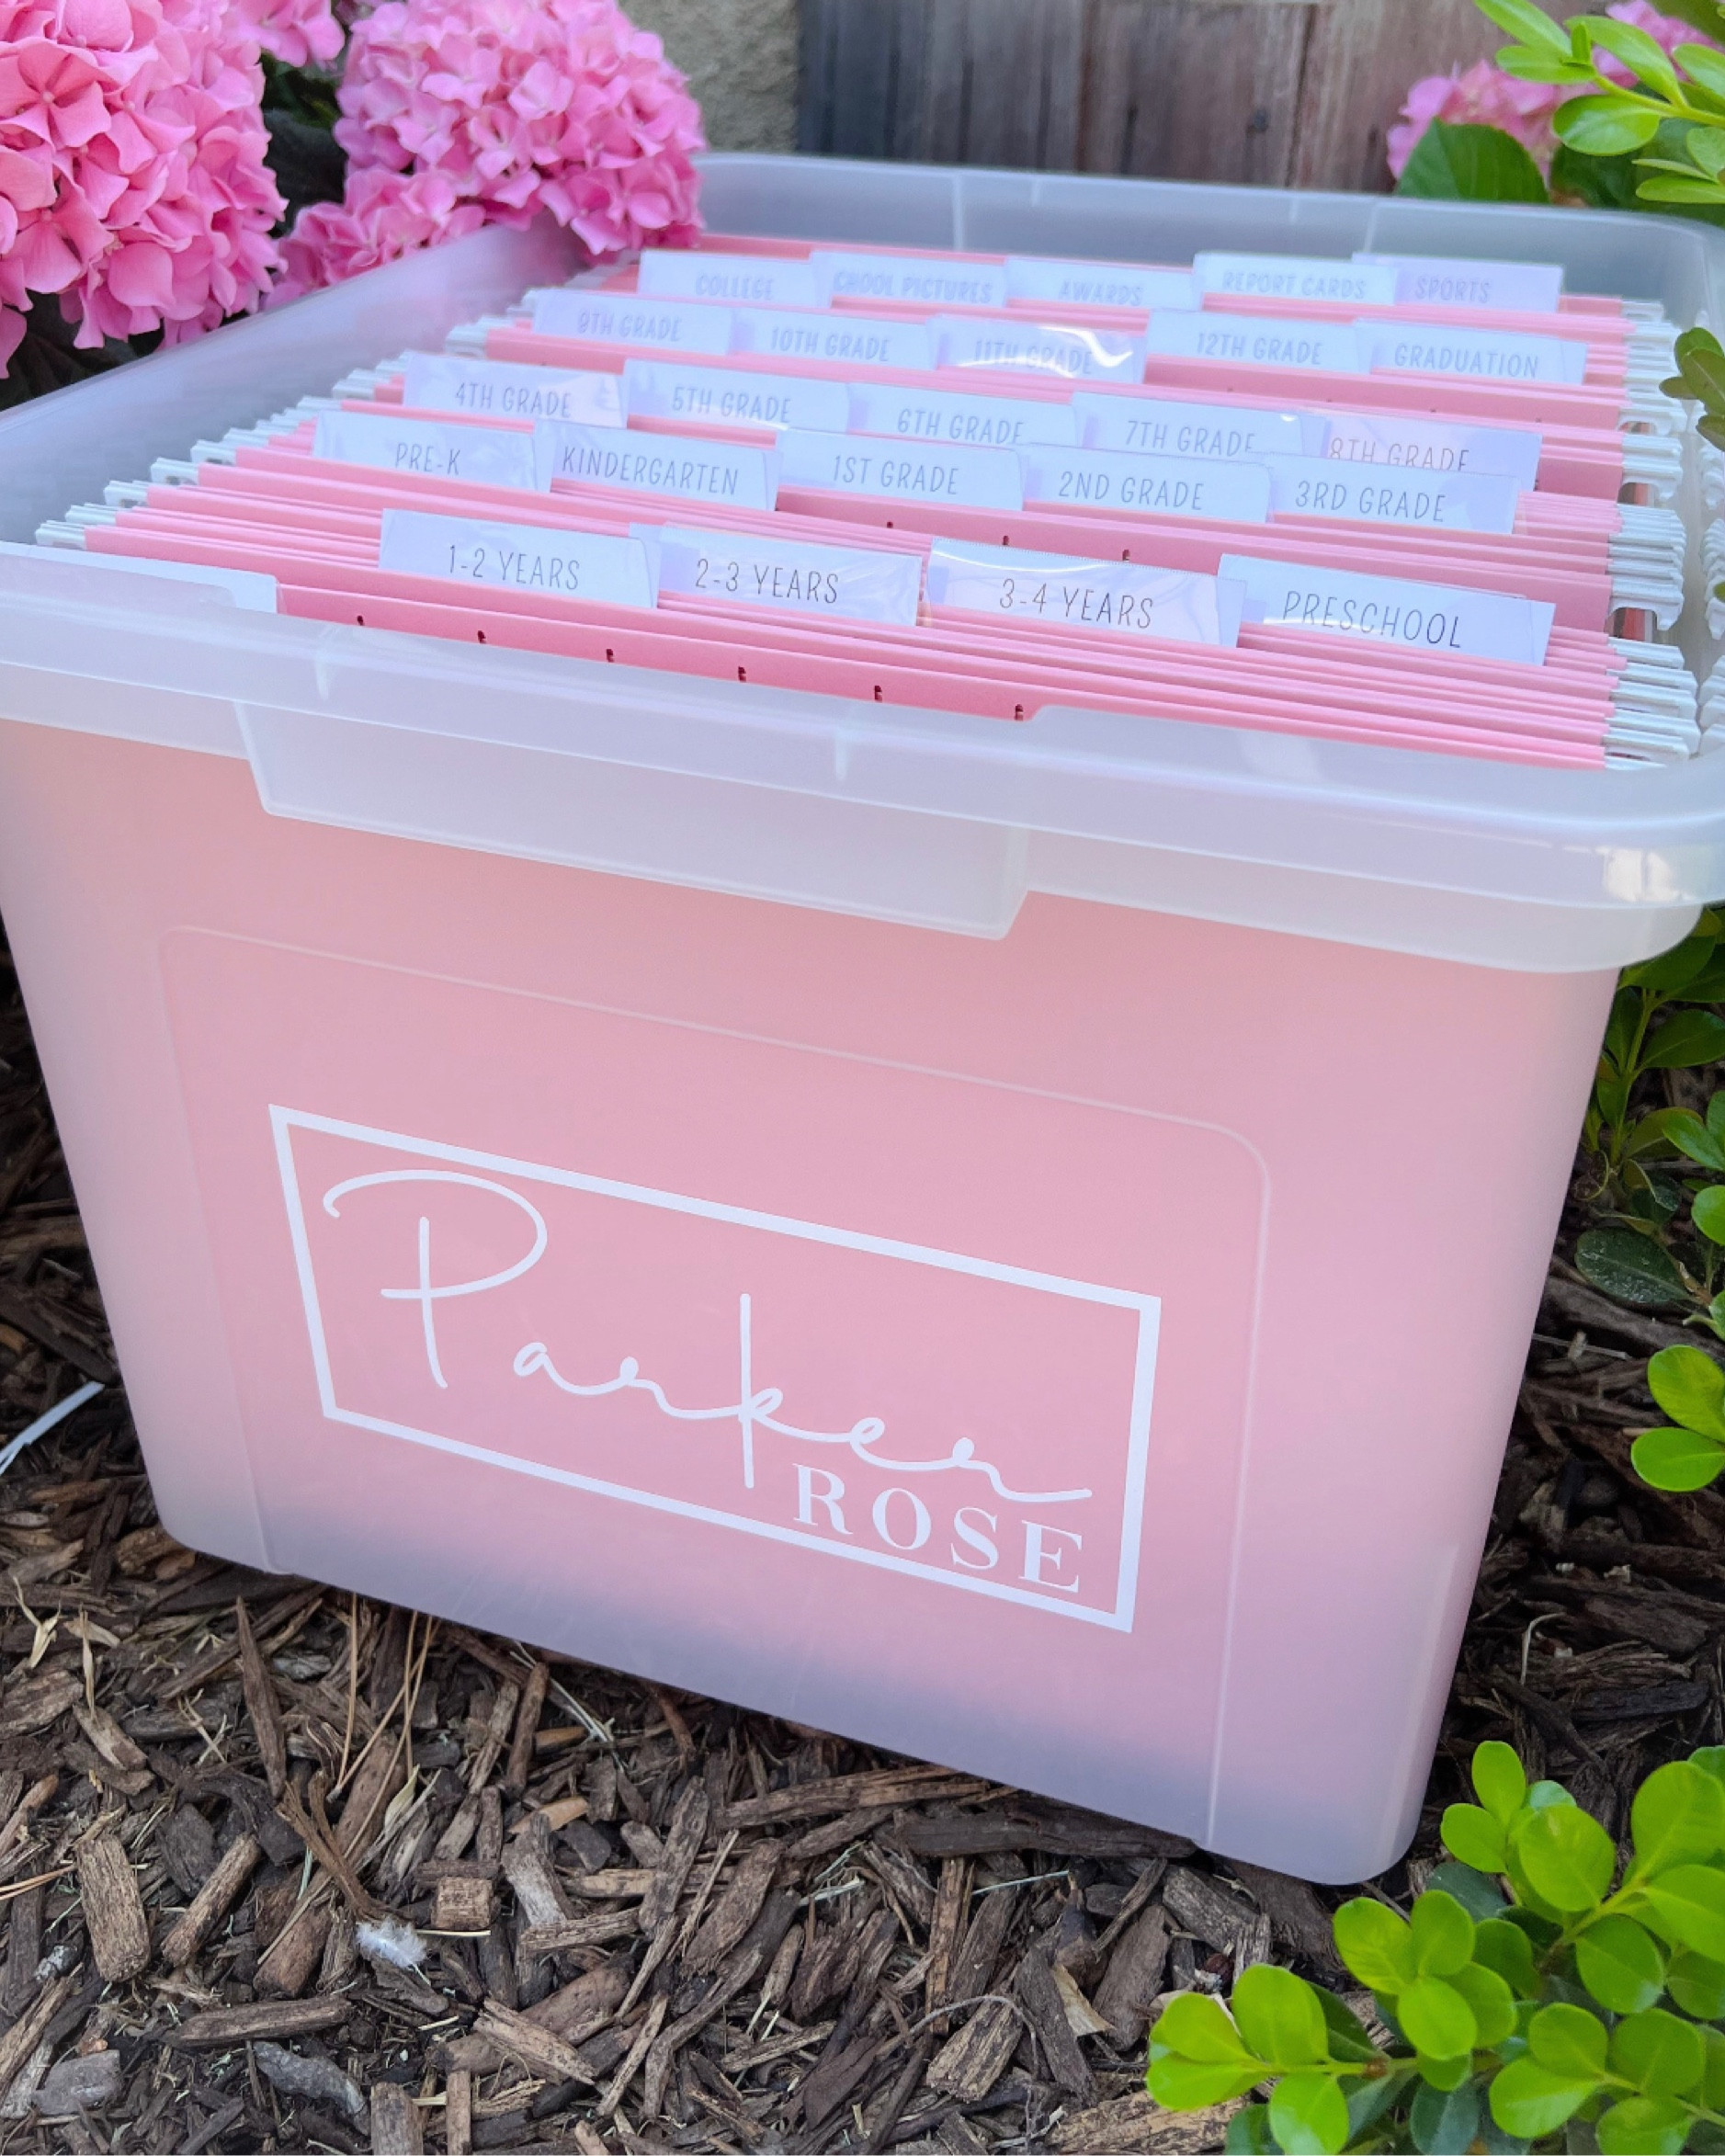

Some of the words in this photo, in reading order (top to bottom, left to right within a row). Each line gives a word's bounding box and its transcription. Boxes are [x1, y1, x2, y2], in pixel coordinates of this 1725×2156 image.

[695, 275, 774, 301] COLLEGE
[1059, 279, 1142, 306] AWARDS
[1222, 272, 1296, 294] REPORT
[1301, 277, 1367, 300] CARDS
[1414, 278, 1491, 304] SPORTS
[619, 315, 683, 342] GRADE
[771, 327, 817, 354] 10TH
[827, 335, 890, 362] GRADE
[974, 339, 1018, 365] 11TH
[1197, 332, 1243, 358] 12TH
[1253, 336, 1322, 365] GRADE
[1394, 344, 1538, 380] GRADUATION
[456, 382, 492, 409] 4TH
[503, 387, 572, 418] GRADE
[672, 386, 712, 413] 5TH
[721, 391, 792, 423] GRADE
[898, 408, 940, 437] 6TH
[949, 414, 1025, 445] GRADE
[1125, 420, 1167, 449] 7TH
[1178, 427, 1255, 455] GRADE
[395, 443, 461, 476] PRE-K
[1331, 437, 1375, 461] 8TH
[562, 446, 738, 494] KINDERGARTEN
[833, 456, 872, 483] 1ST
[880, 461, 959, 495] GRADE
[1058, 471, 1110, 500] 2ND
[1120, 477, 1204, 510] GRADE
[1296, 480, 1346, 510] 3RD
[1359, 487, 1446, 523] GRADE
[448, 544, 485, 579] 1-2
[496, 550, 580, 591] YEARS
[696, 558, 739, 594] 2-3
[754, 570, 838, 605] YEARS
[1000, 579, 1047, 609] 3-4
[1063, 585, 1153, 630] YEARS
[1283, 590, 1461, 650] PRESCHOOL
[323, 1168, 1095, 1502] Parker
[792, 1462, 1084, 1594] ROSE
